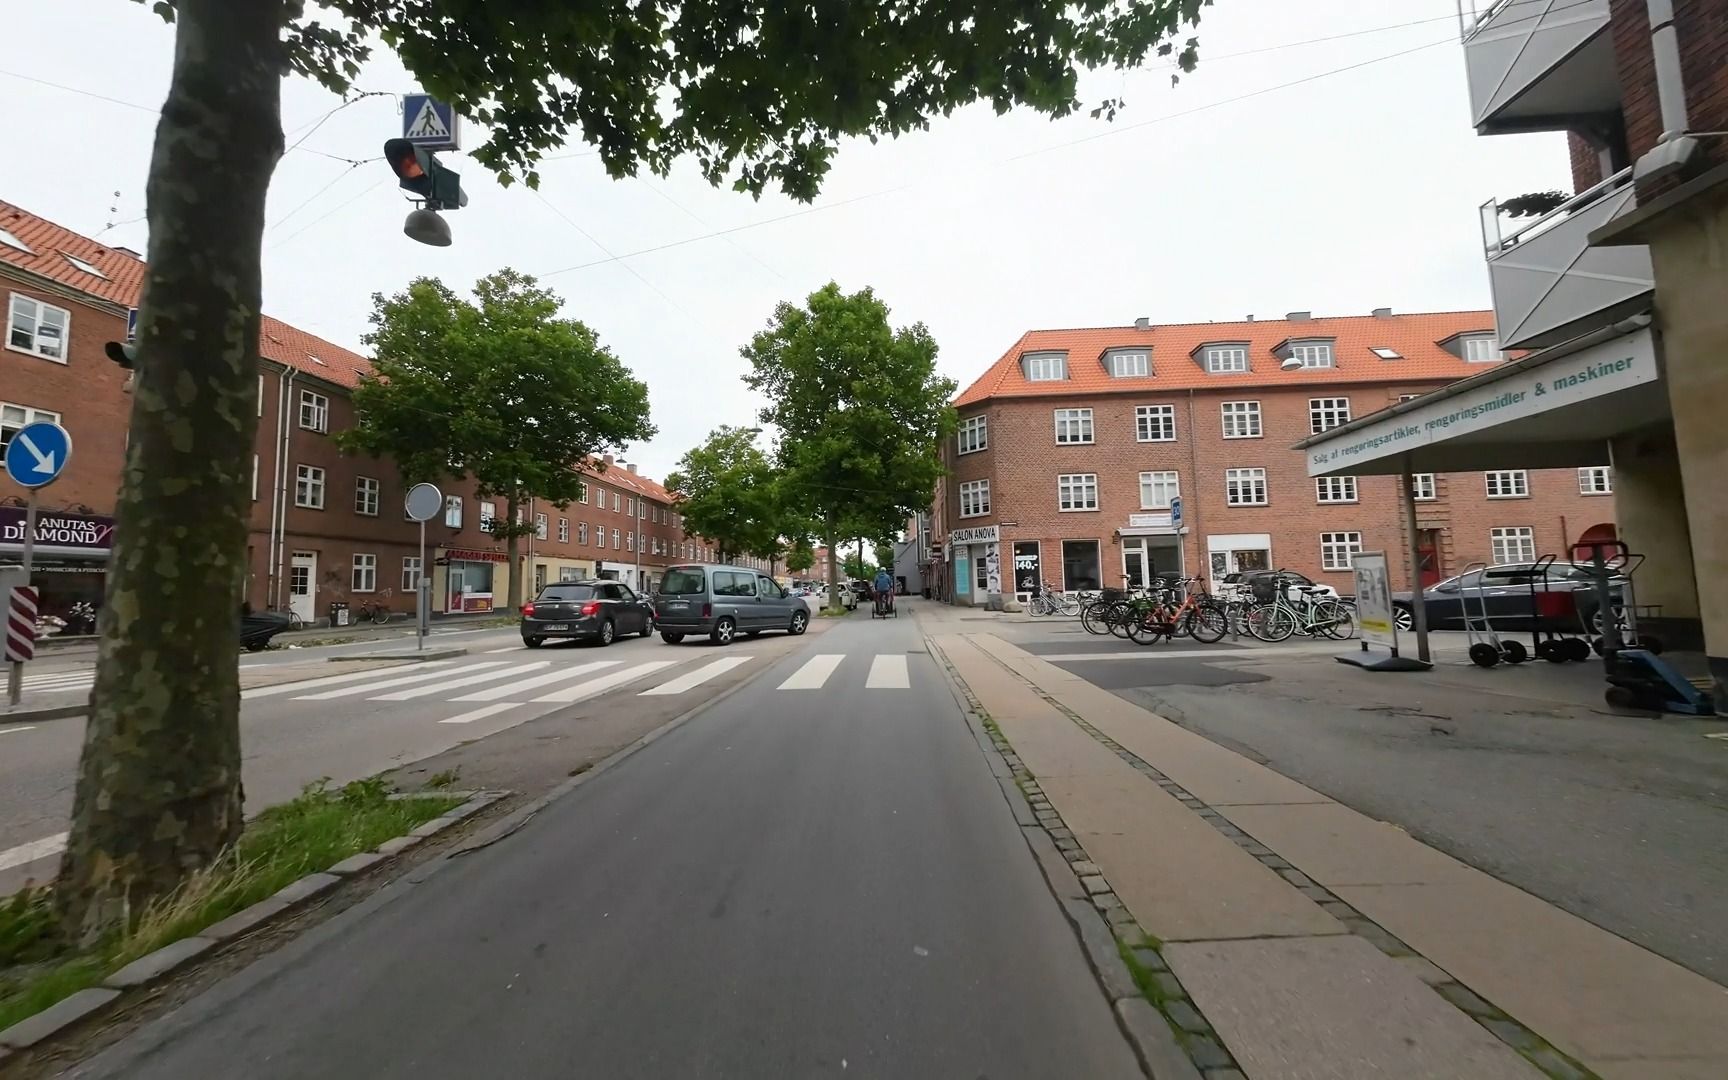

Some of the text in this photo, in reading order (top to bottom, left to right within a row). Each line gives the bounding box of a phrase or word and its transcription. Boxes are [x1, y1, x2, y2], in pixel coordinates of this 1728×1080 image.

[1313, 454, 1328, 465] Salg
[1331, 451, 1339, 460] af
[1425, 390, 1526, 431] rengøringsmidler
[1534, 382, 1547, 397] &
[1553, 356, 1634, 392] maskiner
[4, 521, 98, 544] DIAMOND
[39, 518, 96, 531] ANUTAS
[953, 527, 996, 542] SALON ANOVA
